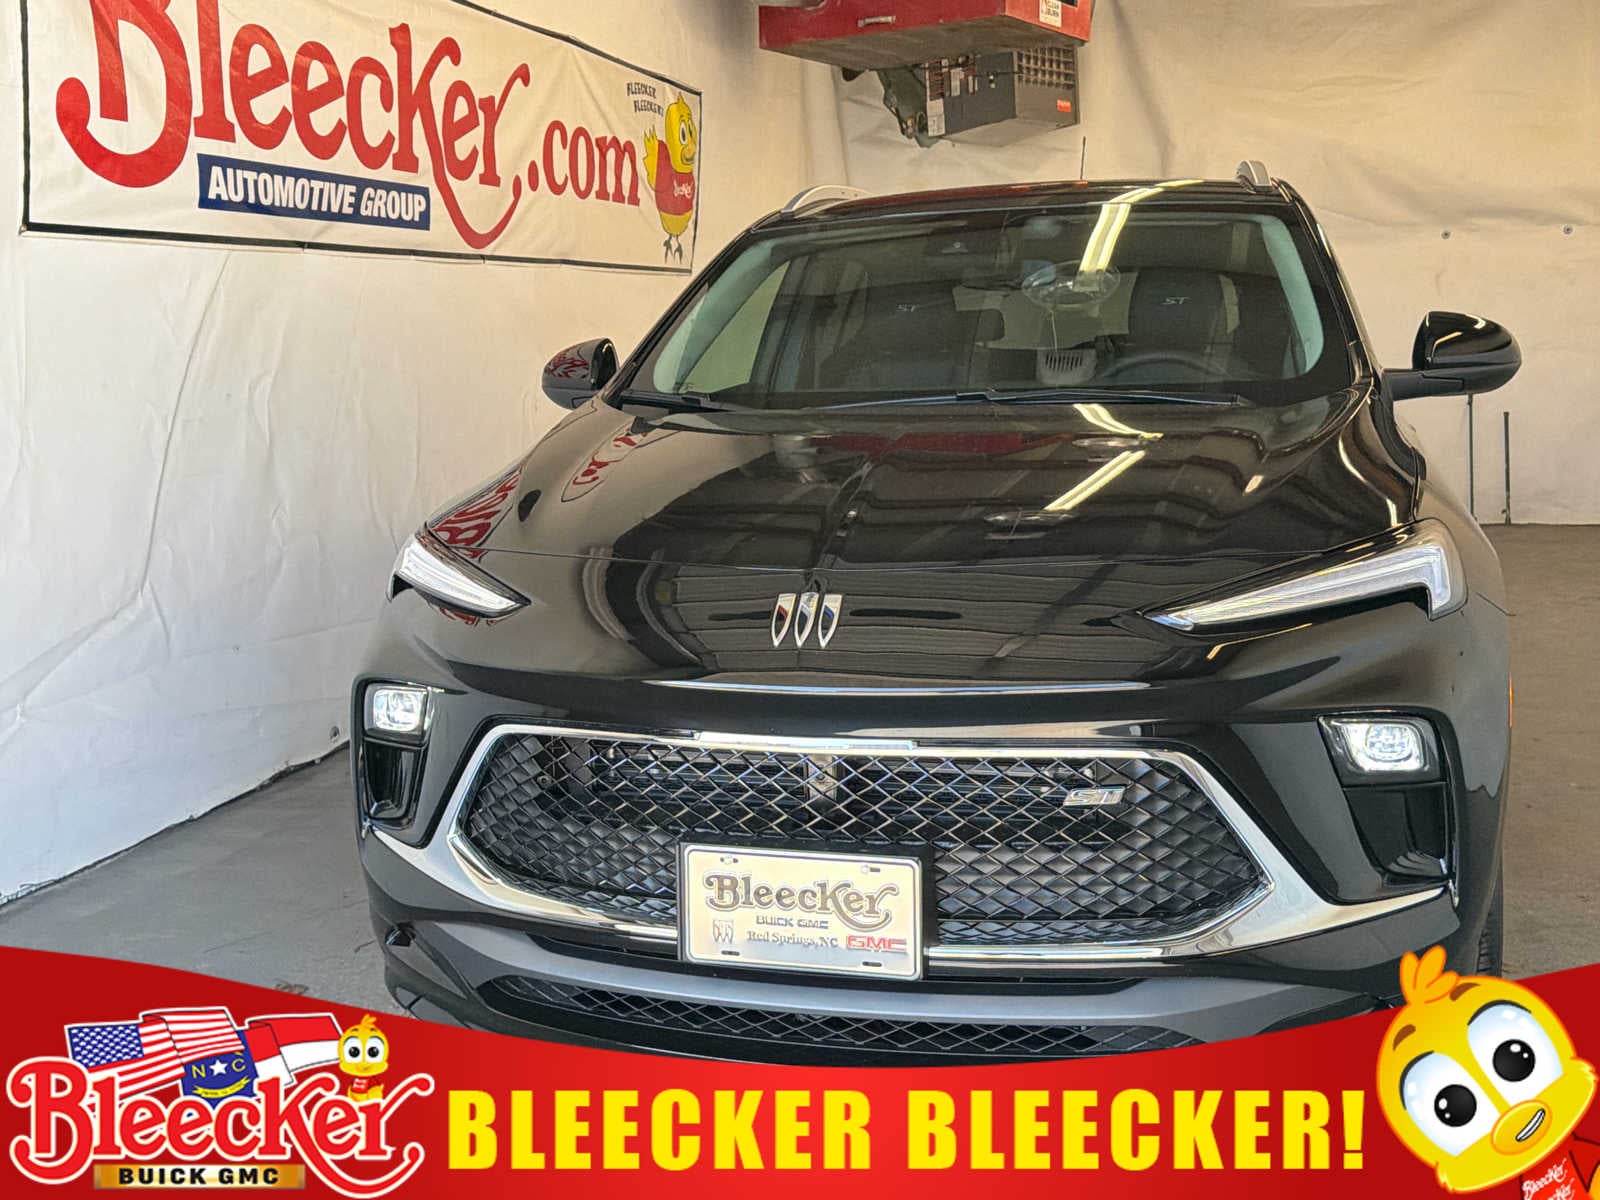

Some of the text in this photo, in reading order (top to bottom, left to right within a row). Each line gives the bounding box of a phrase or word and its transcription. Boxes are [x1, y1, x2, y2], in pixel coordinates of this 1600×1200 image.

[208, 165, 426, 221] AUTOMOTIVE GROUP
[756, 915, 829, 929] BUICK GMC
[747, 930, 770, 942] Red
[847, 935, 907, 951] GMC
